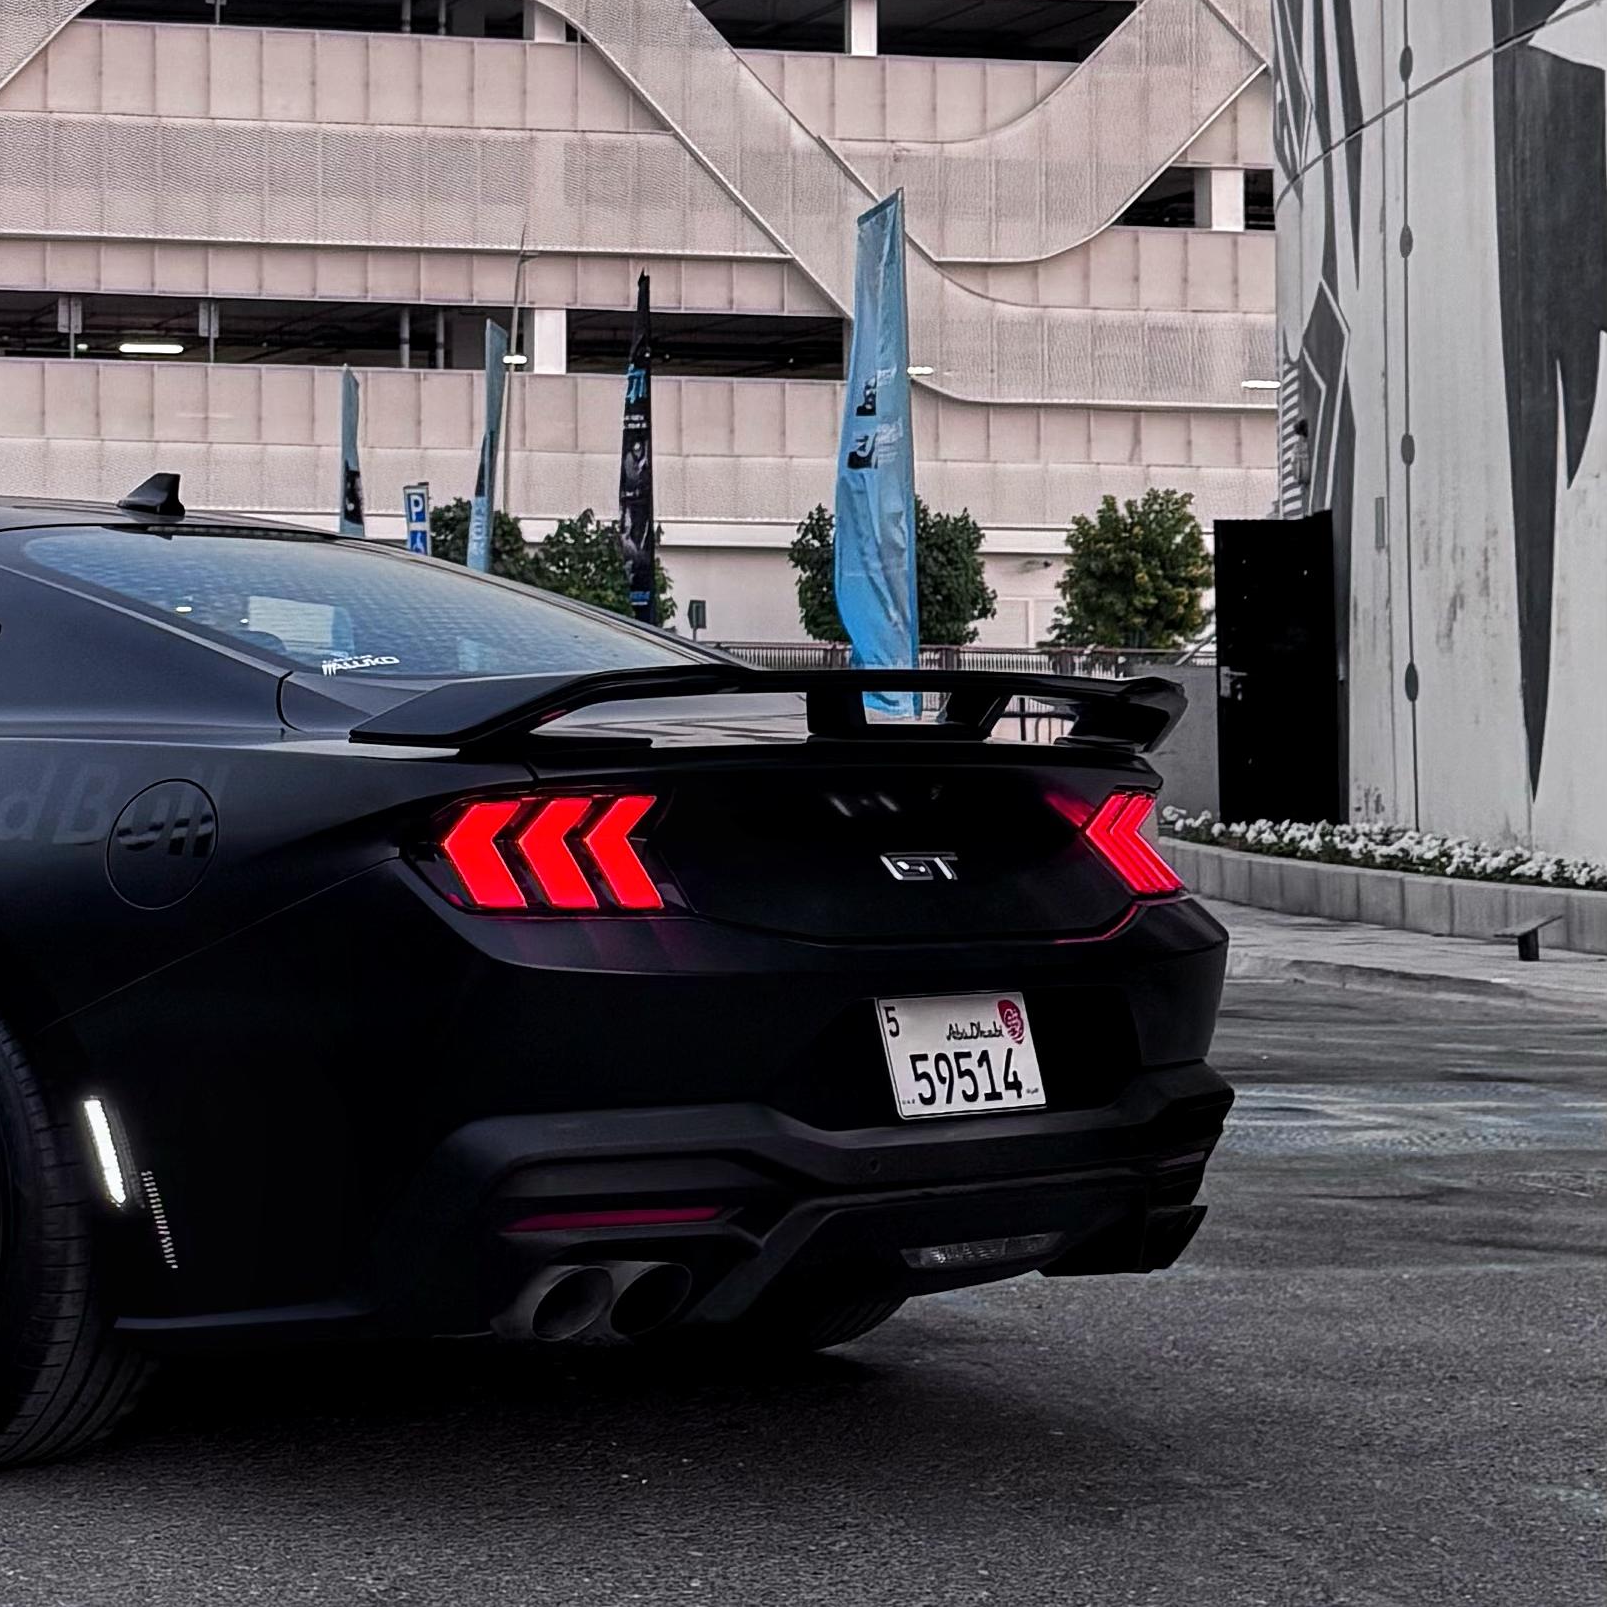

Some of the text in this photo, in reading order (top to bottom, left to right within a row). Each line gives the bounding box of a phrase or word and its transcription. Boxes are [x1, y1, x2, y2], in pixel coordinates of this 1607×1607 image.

[410, 495, 423, 522] P
[880, 851, 958, 880] GT
[884, 1006, 900, 1037] 5
[909, 1047, 1023, 1106] 59514
